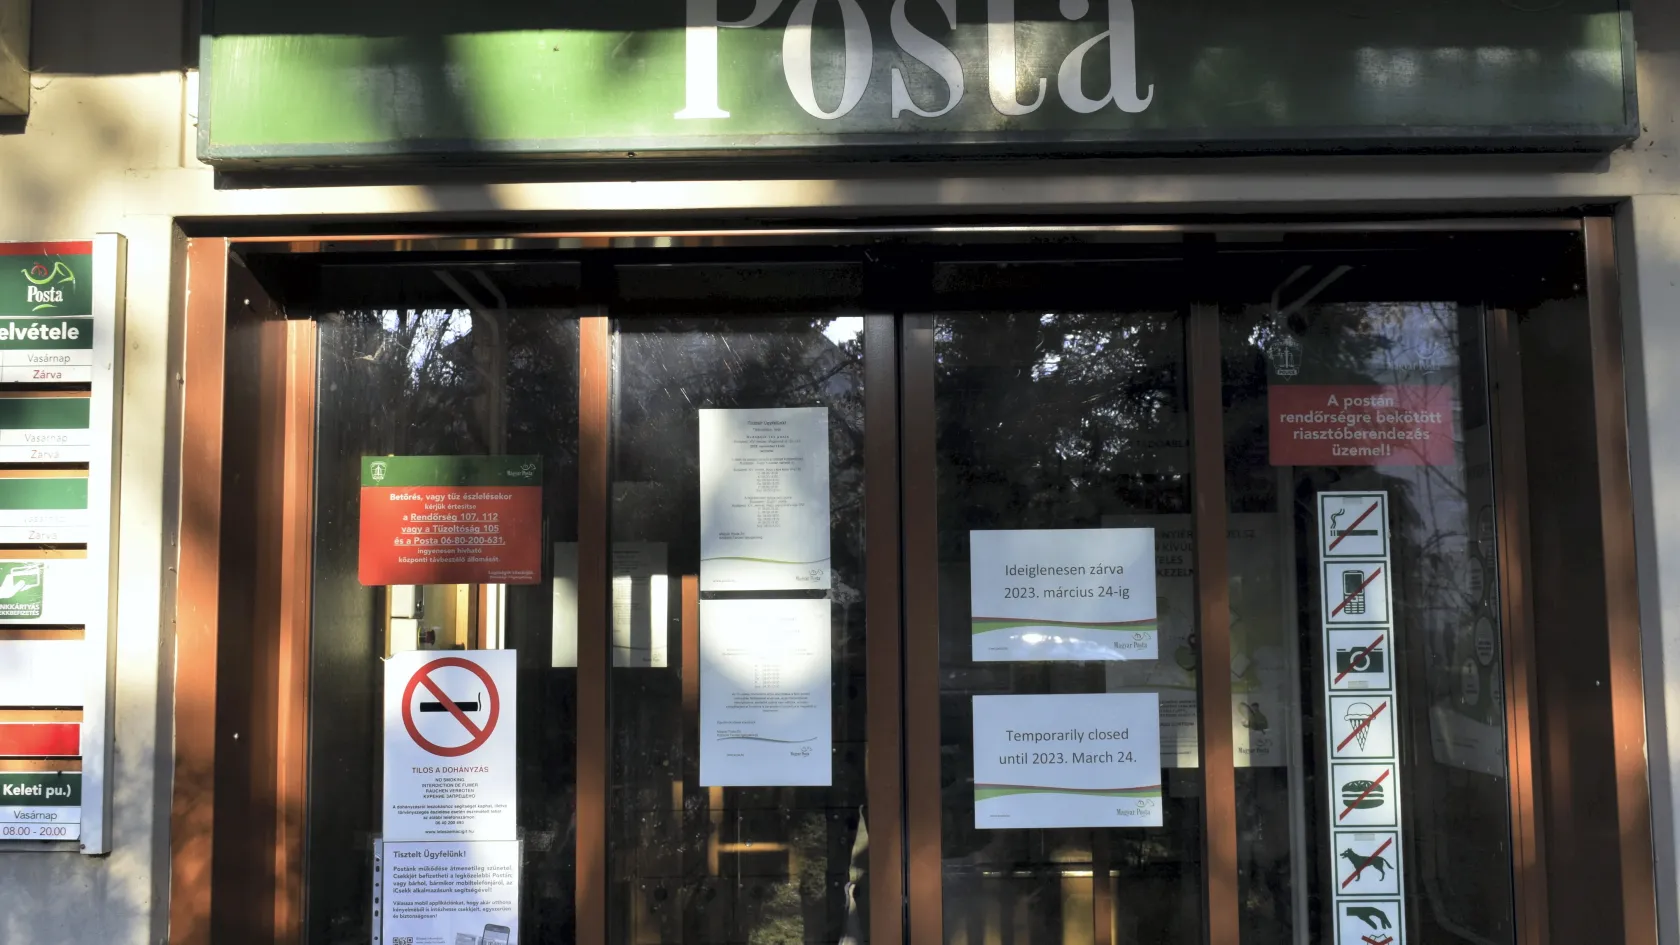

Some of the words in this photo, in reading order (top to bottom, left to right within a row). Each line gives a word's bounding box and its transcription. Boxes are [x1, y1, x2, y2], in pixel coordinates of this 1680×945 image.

[674, 0, 1154, 119] Posta
[27, 285, 63, 303] Posta
[0, 321, 79, 340] elvétele
[28, 354, 71, 364] Vasárnap
[33, 369, 62, 379] Zárva
[1327, 395, 1339, 406] A
[1344, 394, 1394, 409] postán
[1280, 410, 1371, 426] rendőrségre
[1376, 410, 1442, 423] bekötött
[1293, 428, 1429, 440] riasztóberendezés
[1332, 444, 1391, 456] üzemel!
[426, 494, 445, 502] vagy
[411, 513, 457, 522] Rendőrség
[461, 513, 478, 521] 107,
[402, 526, 422, 534] vagy
[433, 524, 480, 534] Tűzoltóság
[1005, 564, 1085, 578] Ideiglenesen
[1090, 564, 1124, 575] zárva
[1005, 587, 1039, 599] 2023.
[1044, 586, 1093, 598] március
[1098, 586, 1130, 599] 24-ig
[1006, 729, 1084, 743] Temporarily
[1088, 728, 1129, 740] closed
[999, 753, 1027, 765] until
[1033, 753, 1068, 764] 2023.
[1073, 752, 1113, 764] March
[1117, 751, 1137, 763] 24.
[443, 765, 489, 773] DOHÁNYZÁS
[3, 784, 42, 796] Keleti
[46, 784, 72, 798] pu.)
[14, 810, 58, 822] Vasárnap
[3, 826, 30, 836] 08.00
[40, 826, 66, 836] 20.00
[424, 850, 466, 859] Ügyfelünk!
